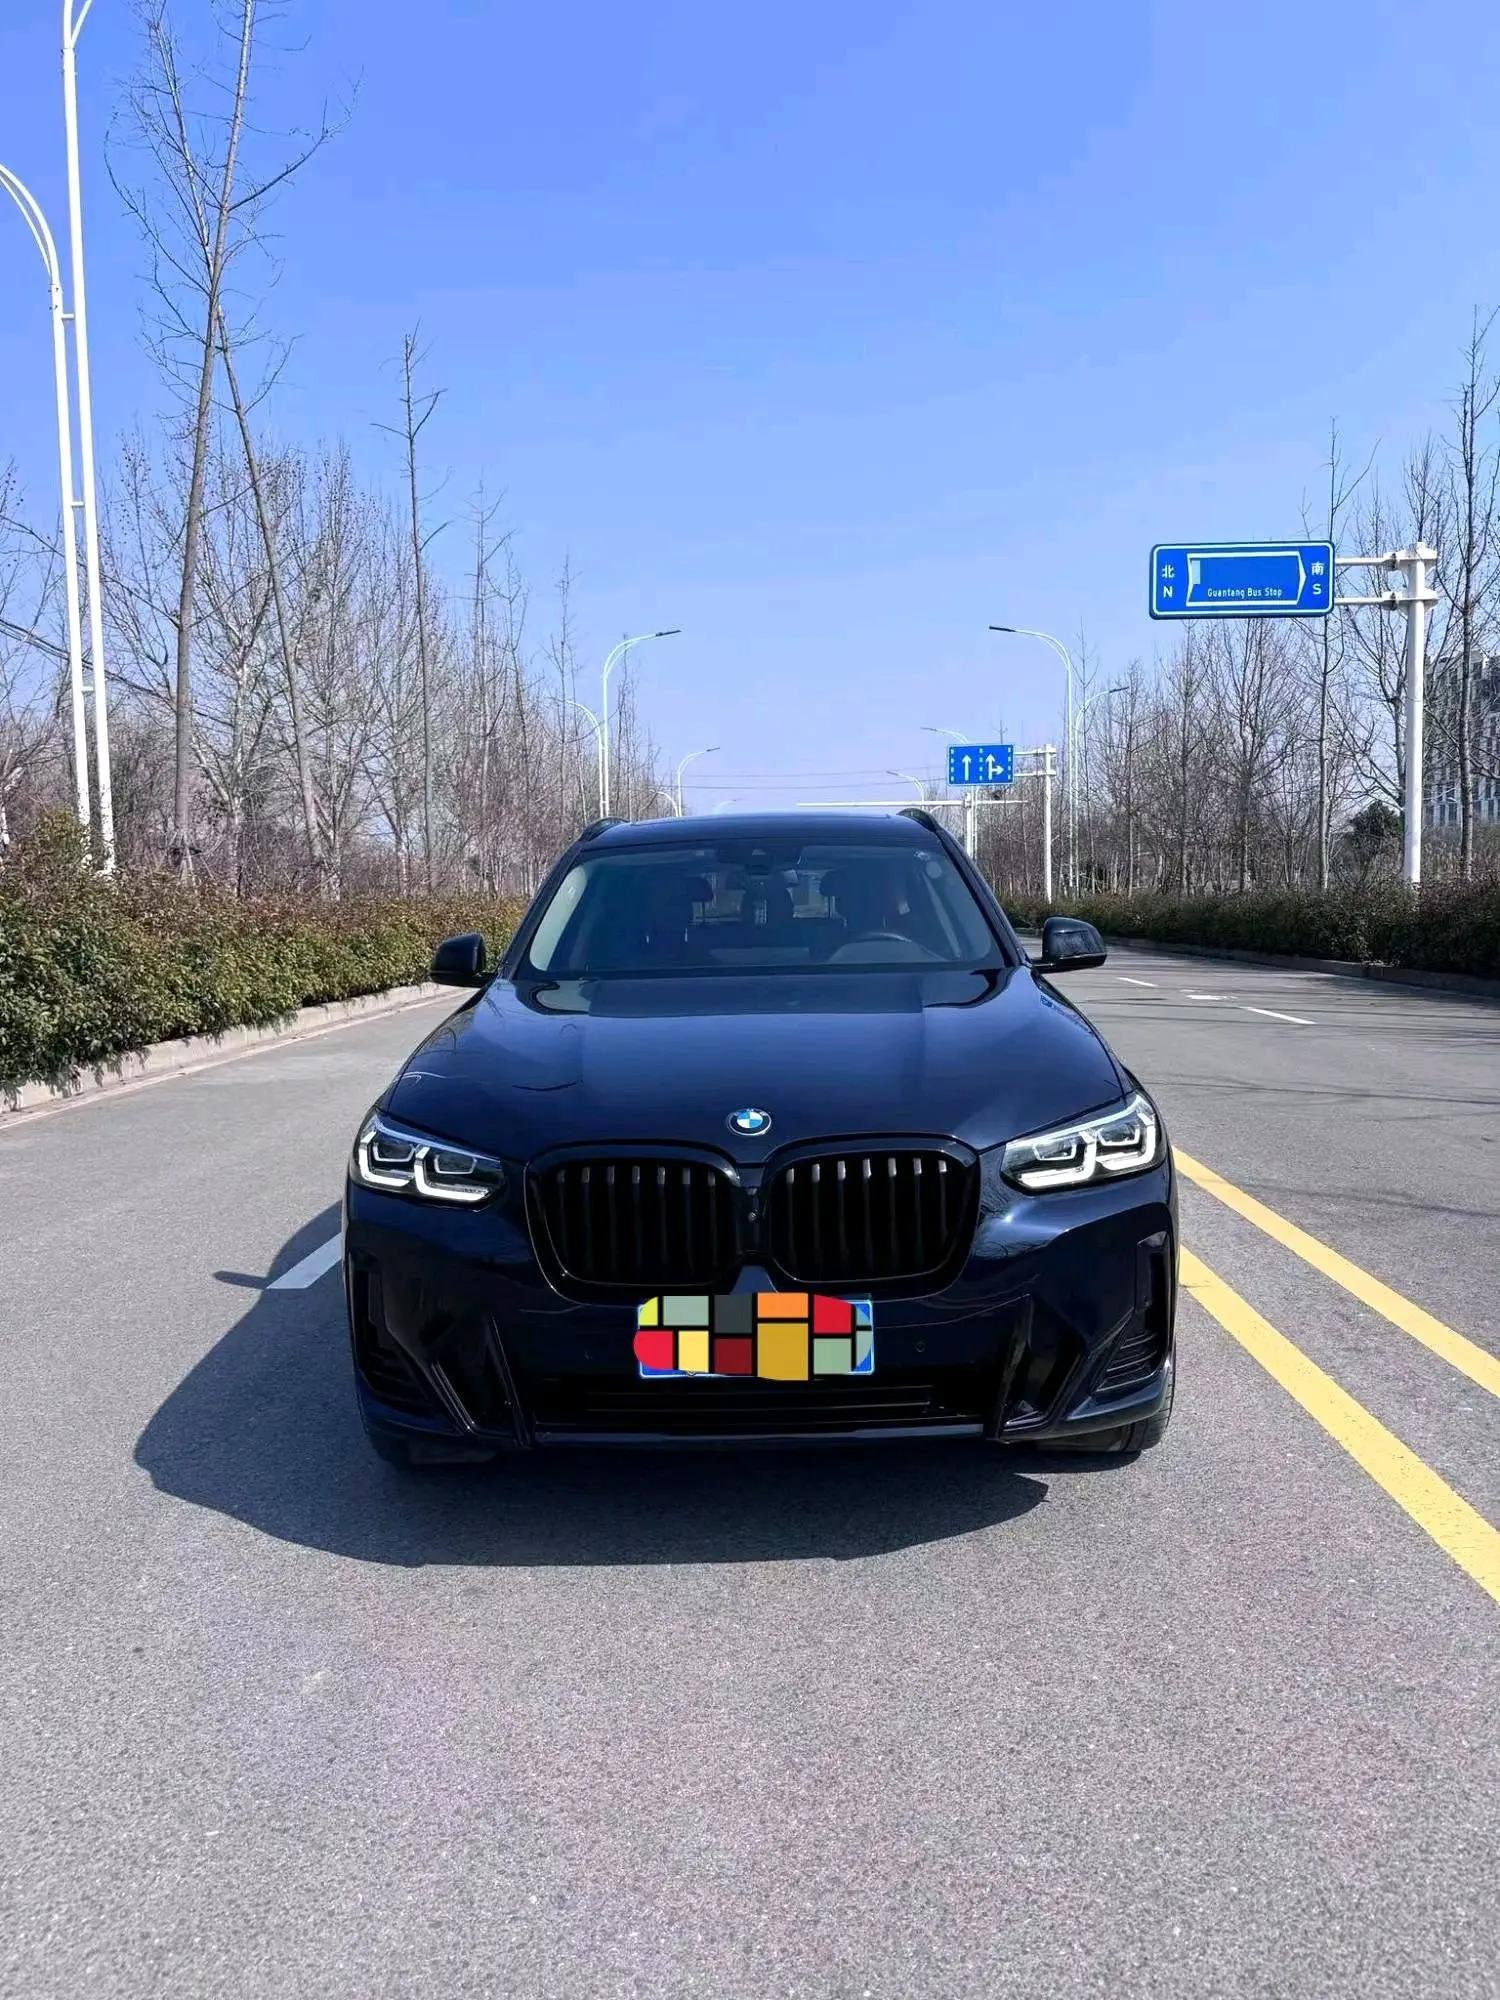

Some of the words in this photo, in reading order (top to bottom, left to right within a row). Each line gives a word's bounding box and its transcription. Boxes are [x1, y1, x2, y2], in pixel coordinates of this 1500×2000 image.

[1161, 564, 1175, 578] 北
[1311, 561, 1324, 576] 南
[1163, 585, 1173, 598] N
[1207, 587, 1245, 600] Guantang
[1247, 587, 1262, 597] Bus
[1264, 587, 1283, 598] Stop
[1312, 583, 1322, 595] S
